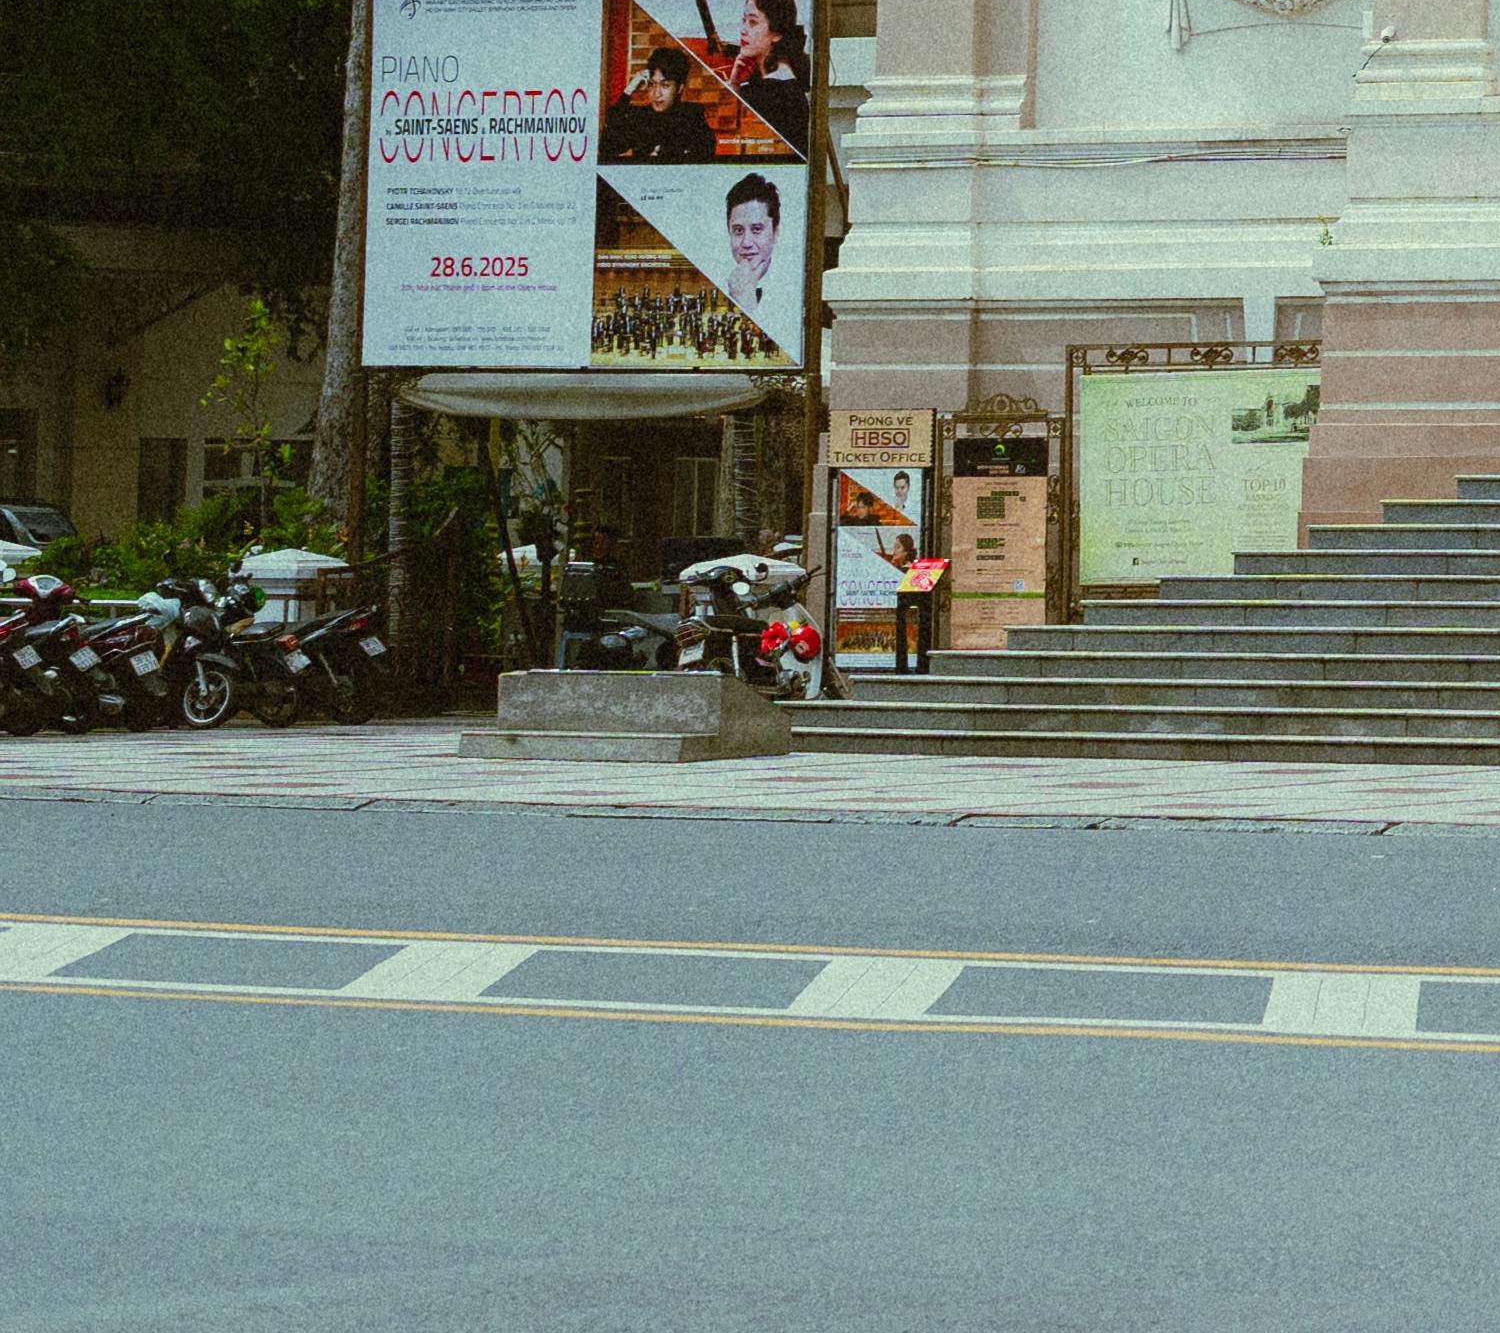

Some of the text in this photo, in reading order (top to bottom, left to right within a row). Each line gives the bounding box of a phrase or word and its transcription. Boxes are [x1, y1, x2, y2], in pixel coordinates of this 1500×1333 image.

[381, 54, 460, 84] PIANO
[380, 88, 588, 164] CONCERTOS
[395, 118, 478, 136] SAINT-SAENS
[489, 116, 587, 135] RACHMANINOV
[430, 255, 530, 278] 28.6.2025
[1125, 395, 1198, 410] WELCOME TO
[854, 431, 907, 446] HBSO
[1104, 414, 1217, 443] SAIGON
[1104, 444, 1217, 474] OPERA
[1104, 475, 1217, 507] HOUSE
[1242, 478, 1271, 493] TOP
